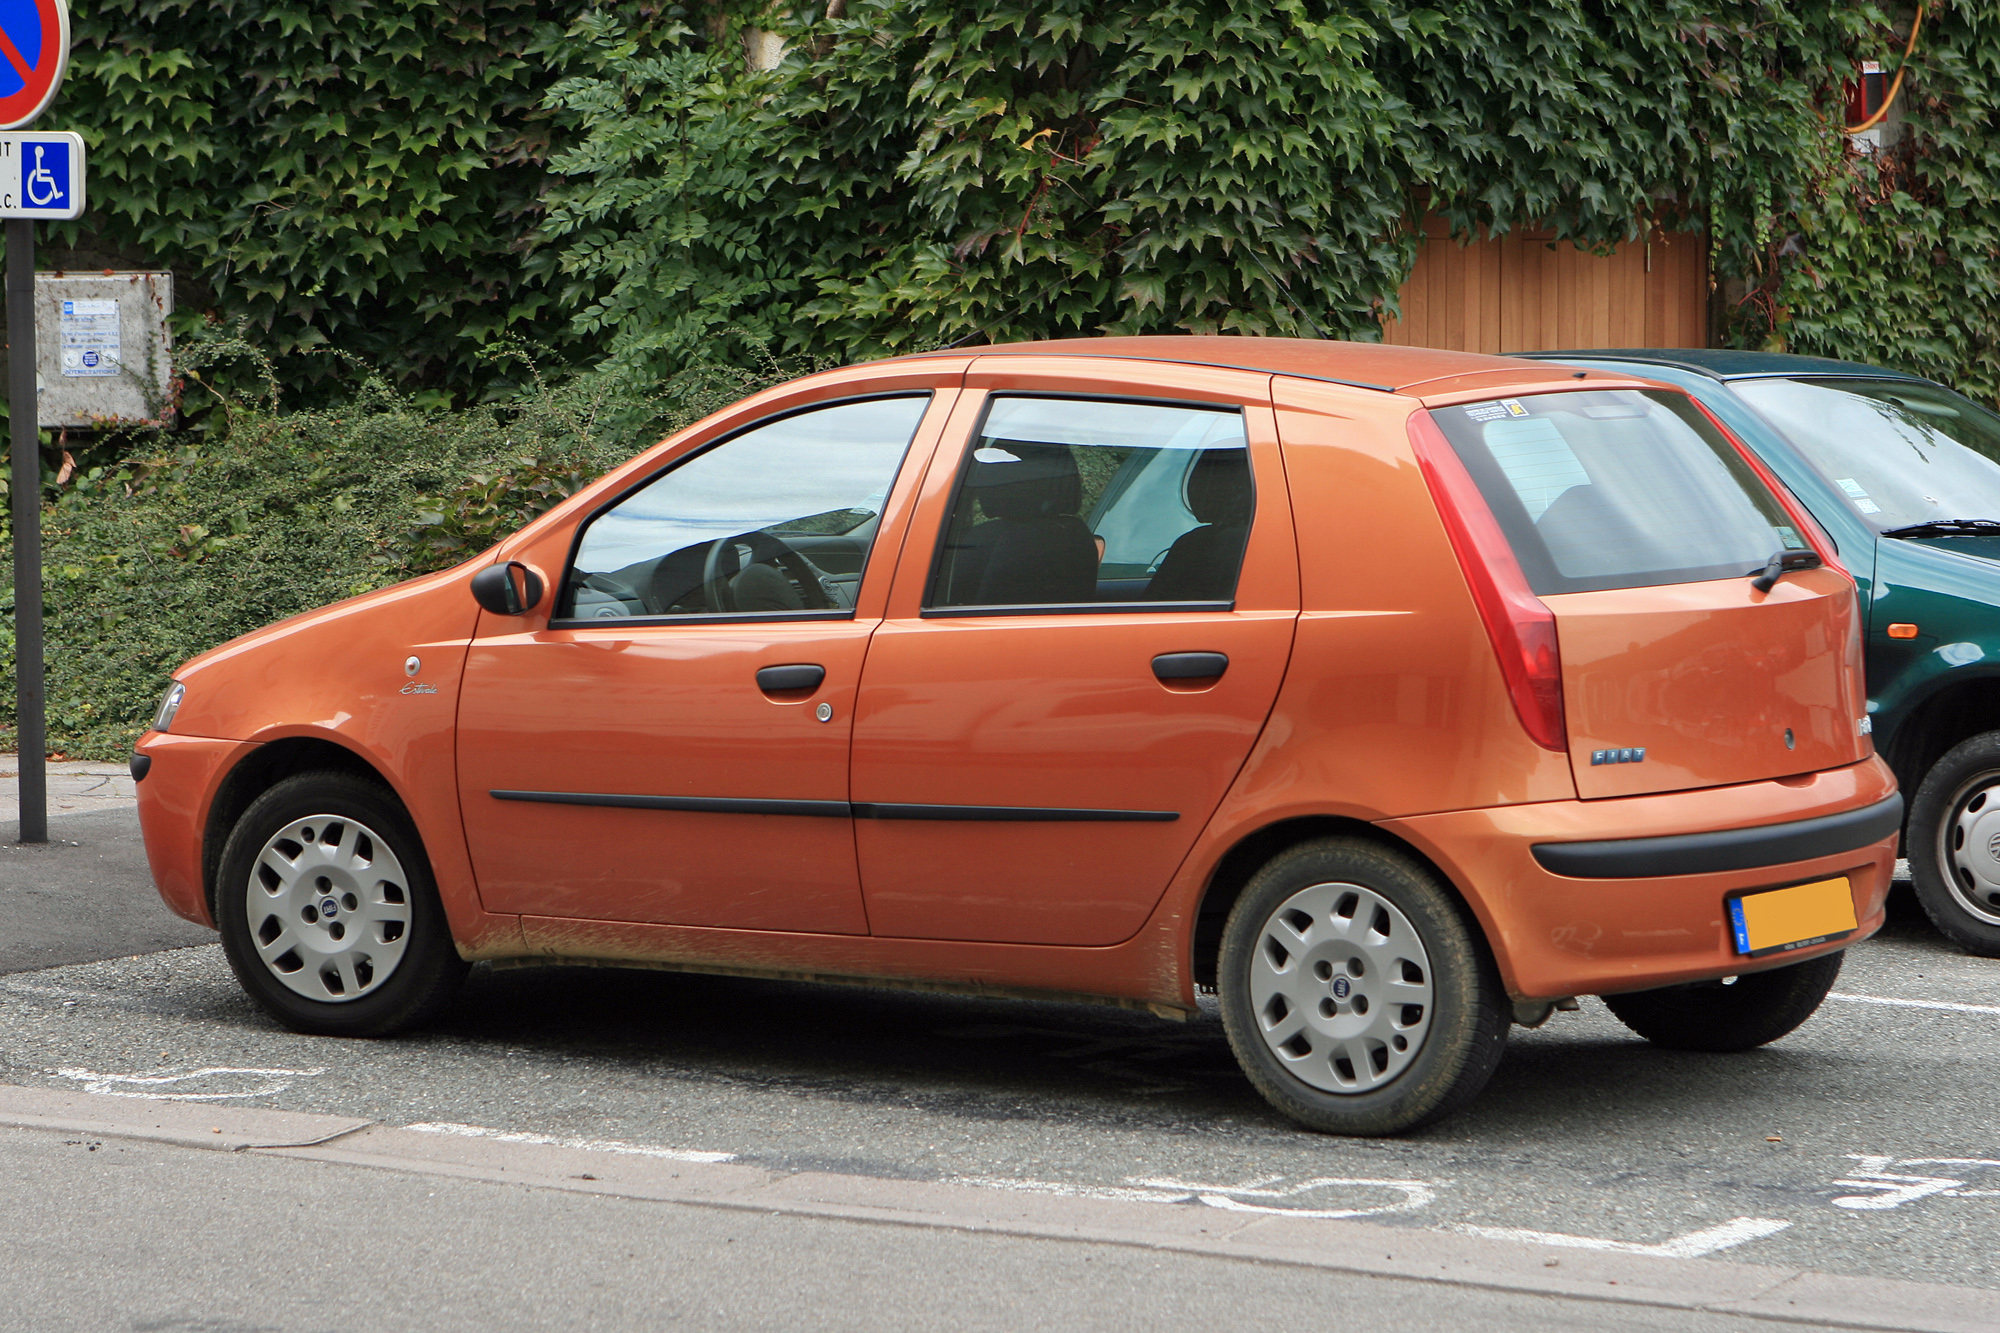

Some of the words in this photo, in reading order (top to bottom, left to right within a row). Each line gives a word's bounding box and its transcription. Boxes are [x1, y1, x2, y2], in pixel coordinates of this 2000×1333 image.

[399, 681, 438, 695] Estivale
[1593, 748, 1644, 763] FIAT
[1337, 979, 1346, 997] FIAT
